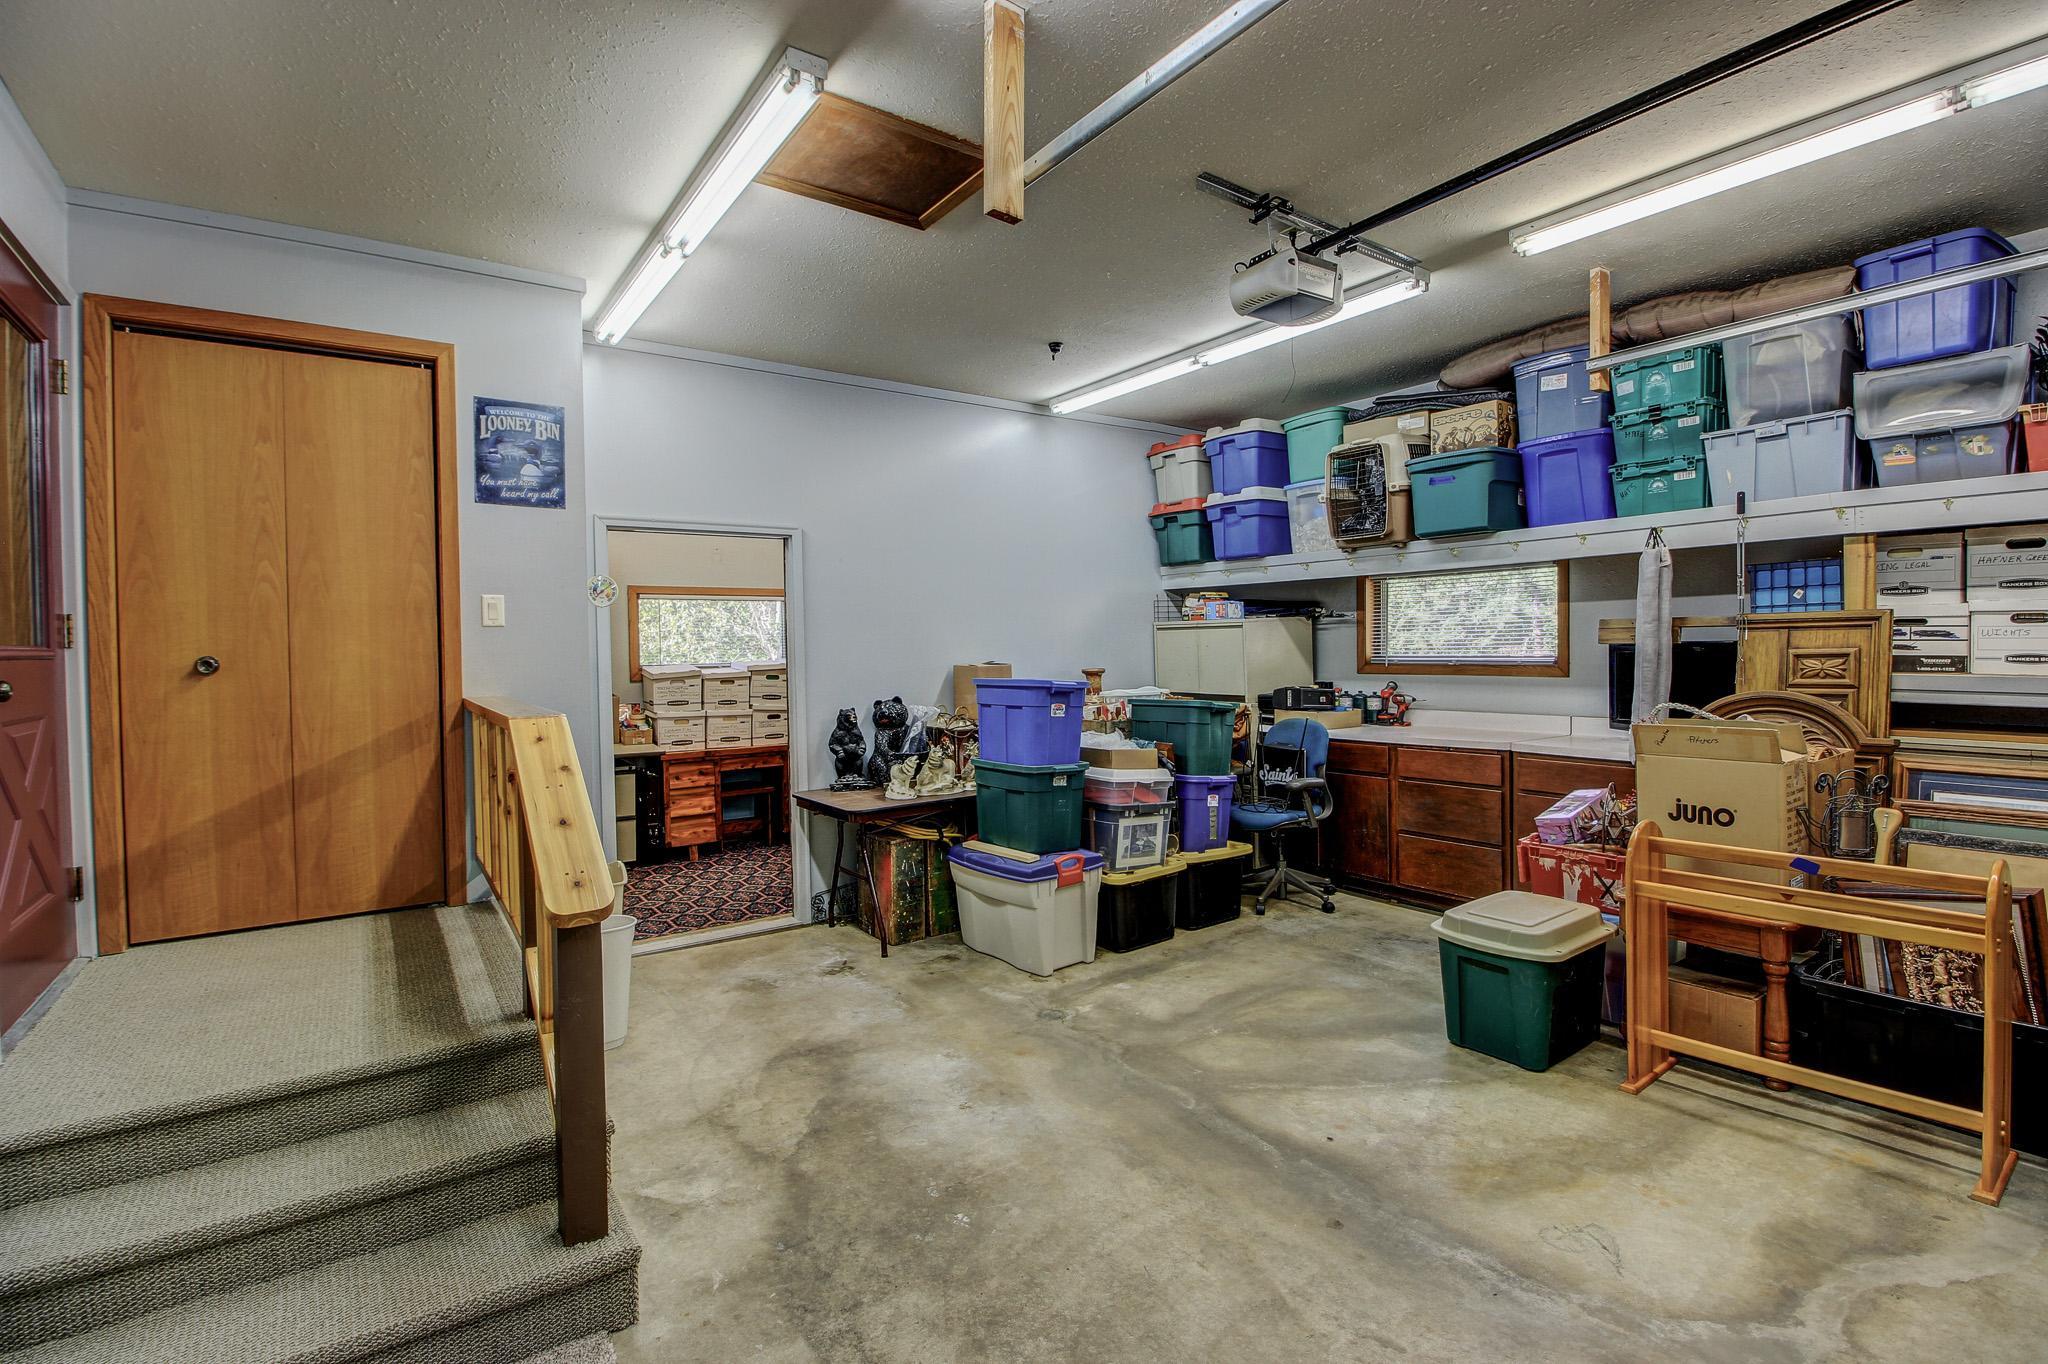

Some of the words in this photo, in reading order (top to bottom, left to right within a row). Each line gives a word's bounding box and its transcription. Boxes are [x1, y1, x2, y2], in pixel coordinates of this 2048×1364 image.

[489, 409, 524, 417] WELCOME
[480, 415, 532, 439] LOONEY
[535, 419, 560, 441] BIN
[480, 474, 495, 487] You
[497, 478, 517, 486] must
[518, 478, 537, 487] have
[500, 487, 526, 498] heard
[527, 489, 539, 502] my
[1904, 561, 1931, 570] LEGAL
[1667, 798, 1735, 828] juno
